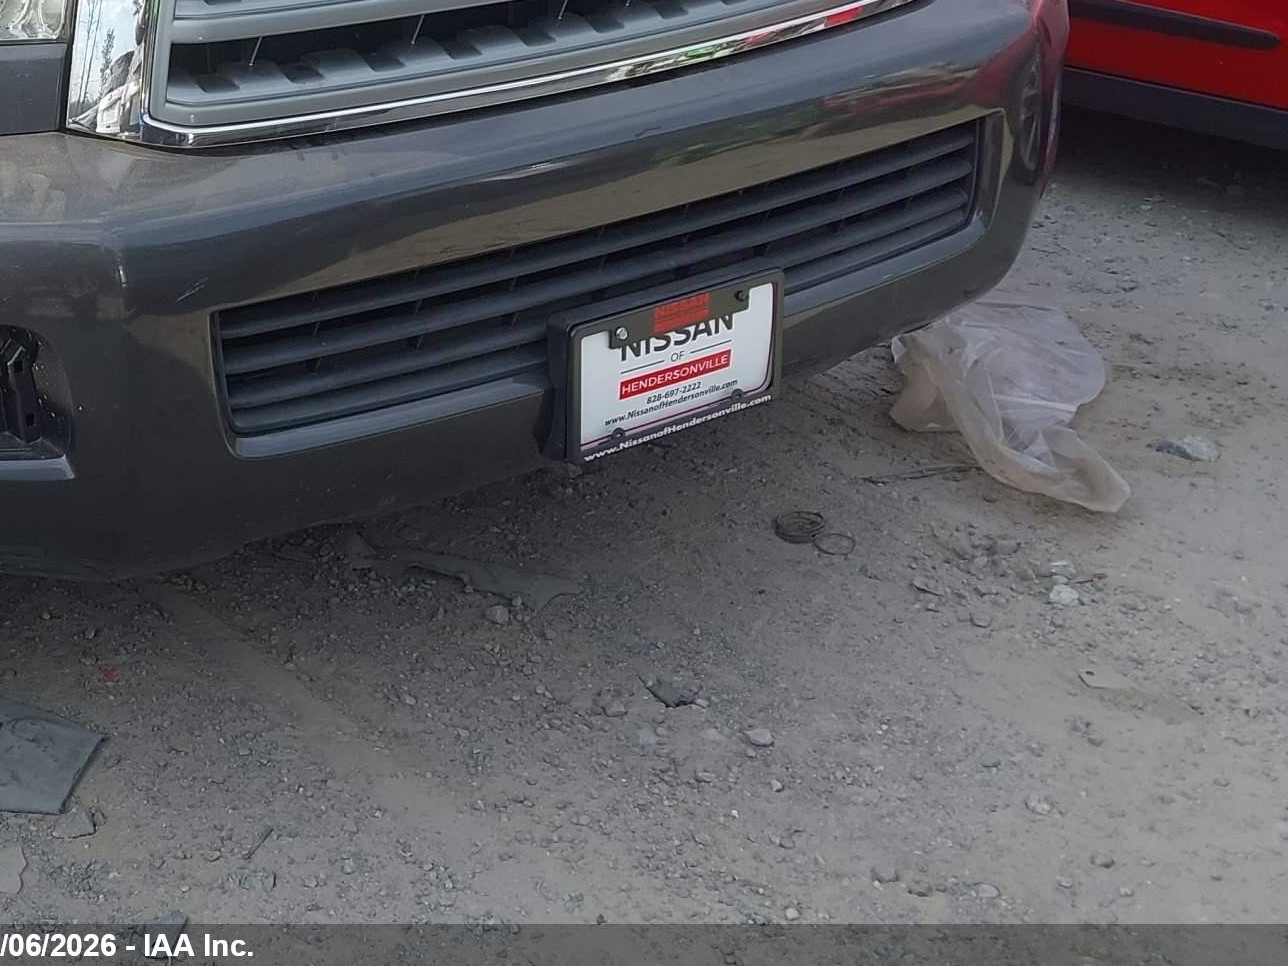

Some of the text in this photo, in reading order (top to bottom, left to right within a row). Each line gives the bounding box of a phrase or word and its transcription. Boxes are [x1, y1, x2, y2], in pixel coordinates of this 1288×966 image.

[622, 354, 728, 395] HENDERSONVILLE
[670, 351, 685, 363] OF
[604, 378, 738, 426] www.NissanofHendersonville.com
[646, 381, 702, 405] 828-697-2222
[584, 394, 772, 462] www.NissanofHendersonville.com
